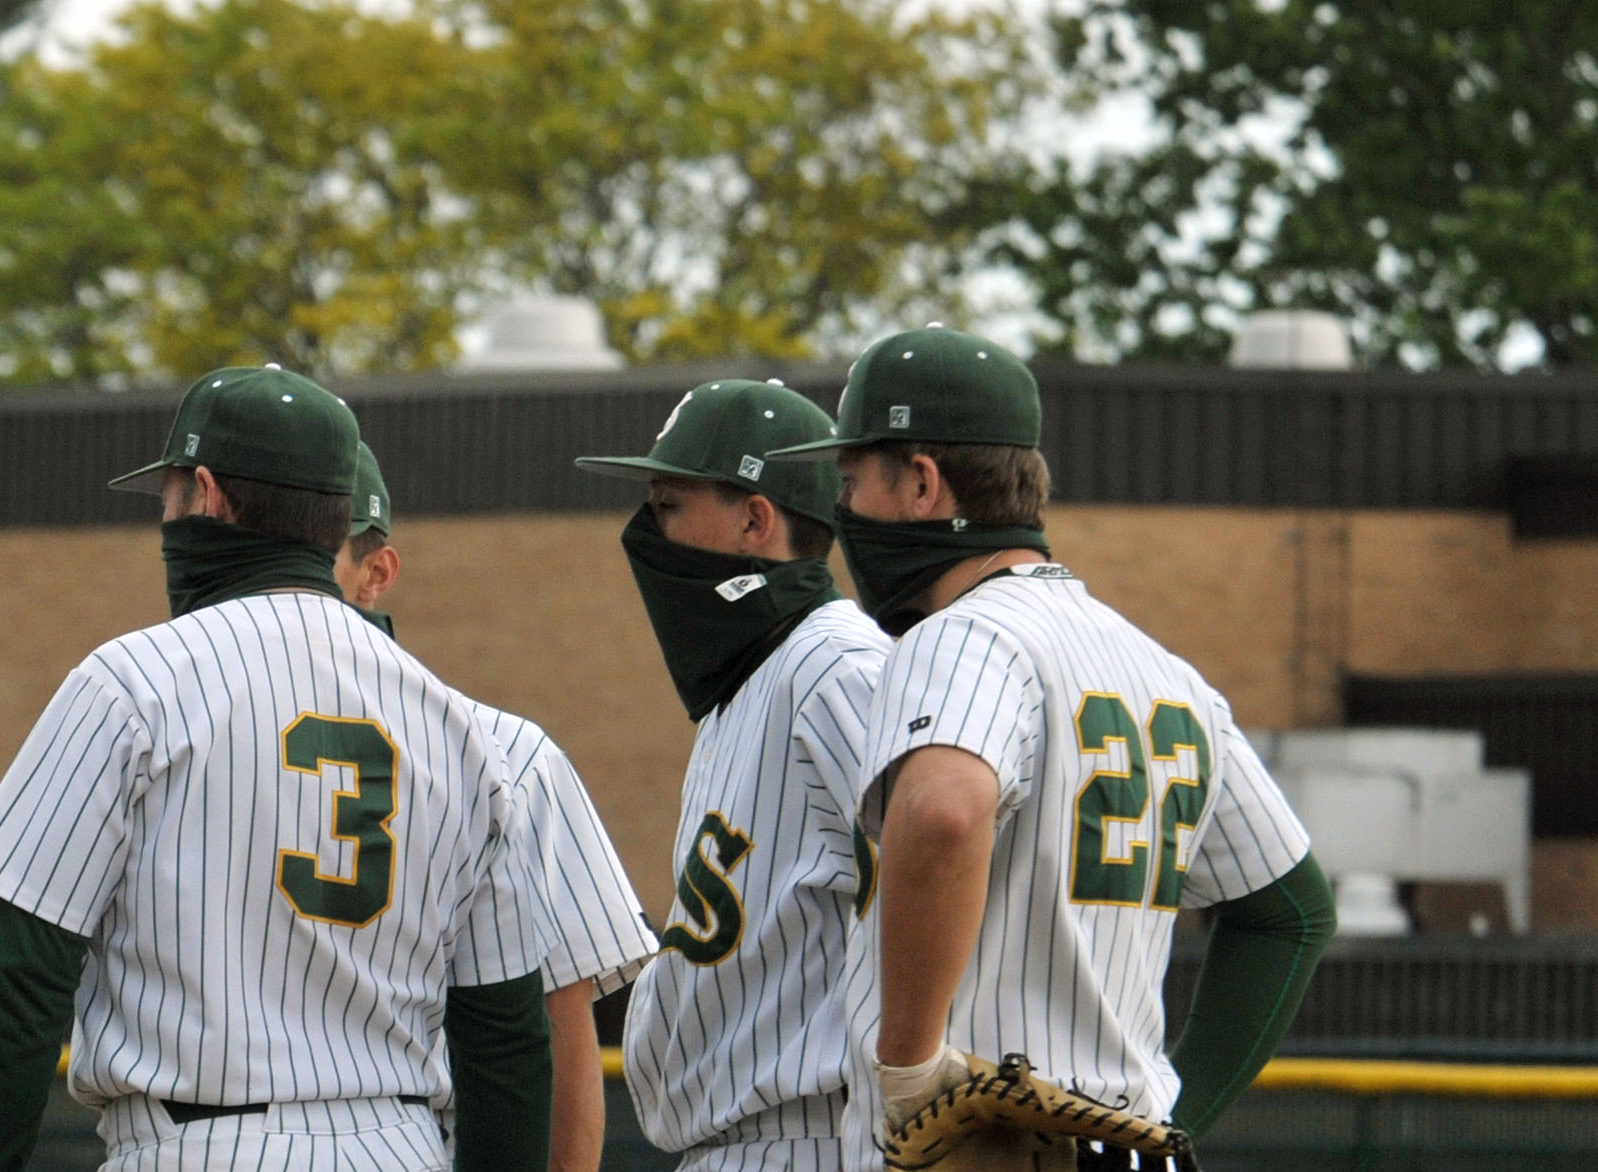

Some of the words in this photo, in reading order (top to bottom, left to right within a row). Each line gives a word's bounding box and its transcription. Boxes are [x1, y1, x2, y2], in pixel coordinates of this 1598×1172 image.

[276, 711, 400, 929] 3
[657, 810, 755, 967] S
[1068, 690, 1214, 912] 22
